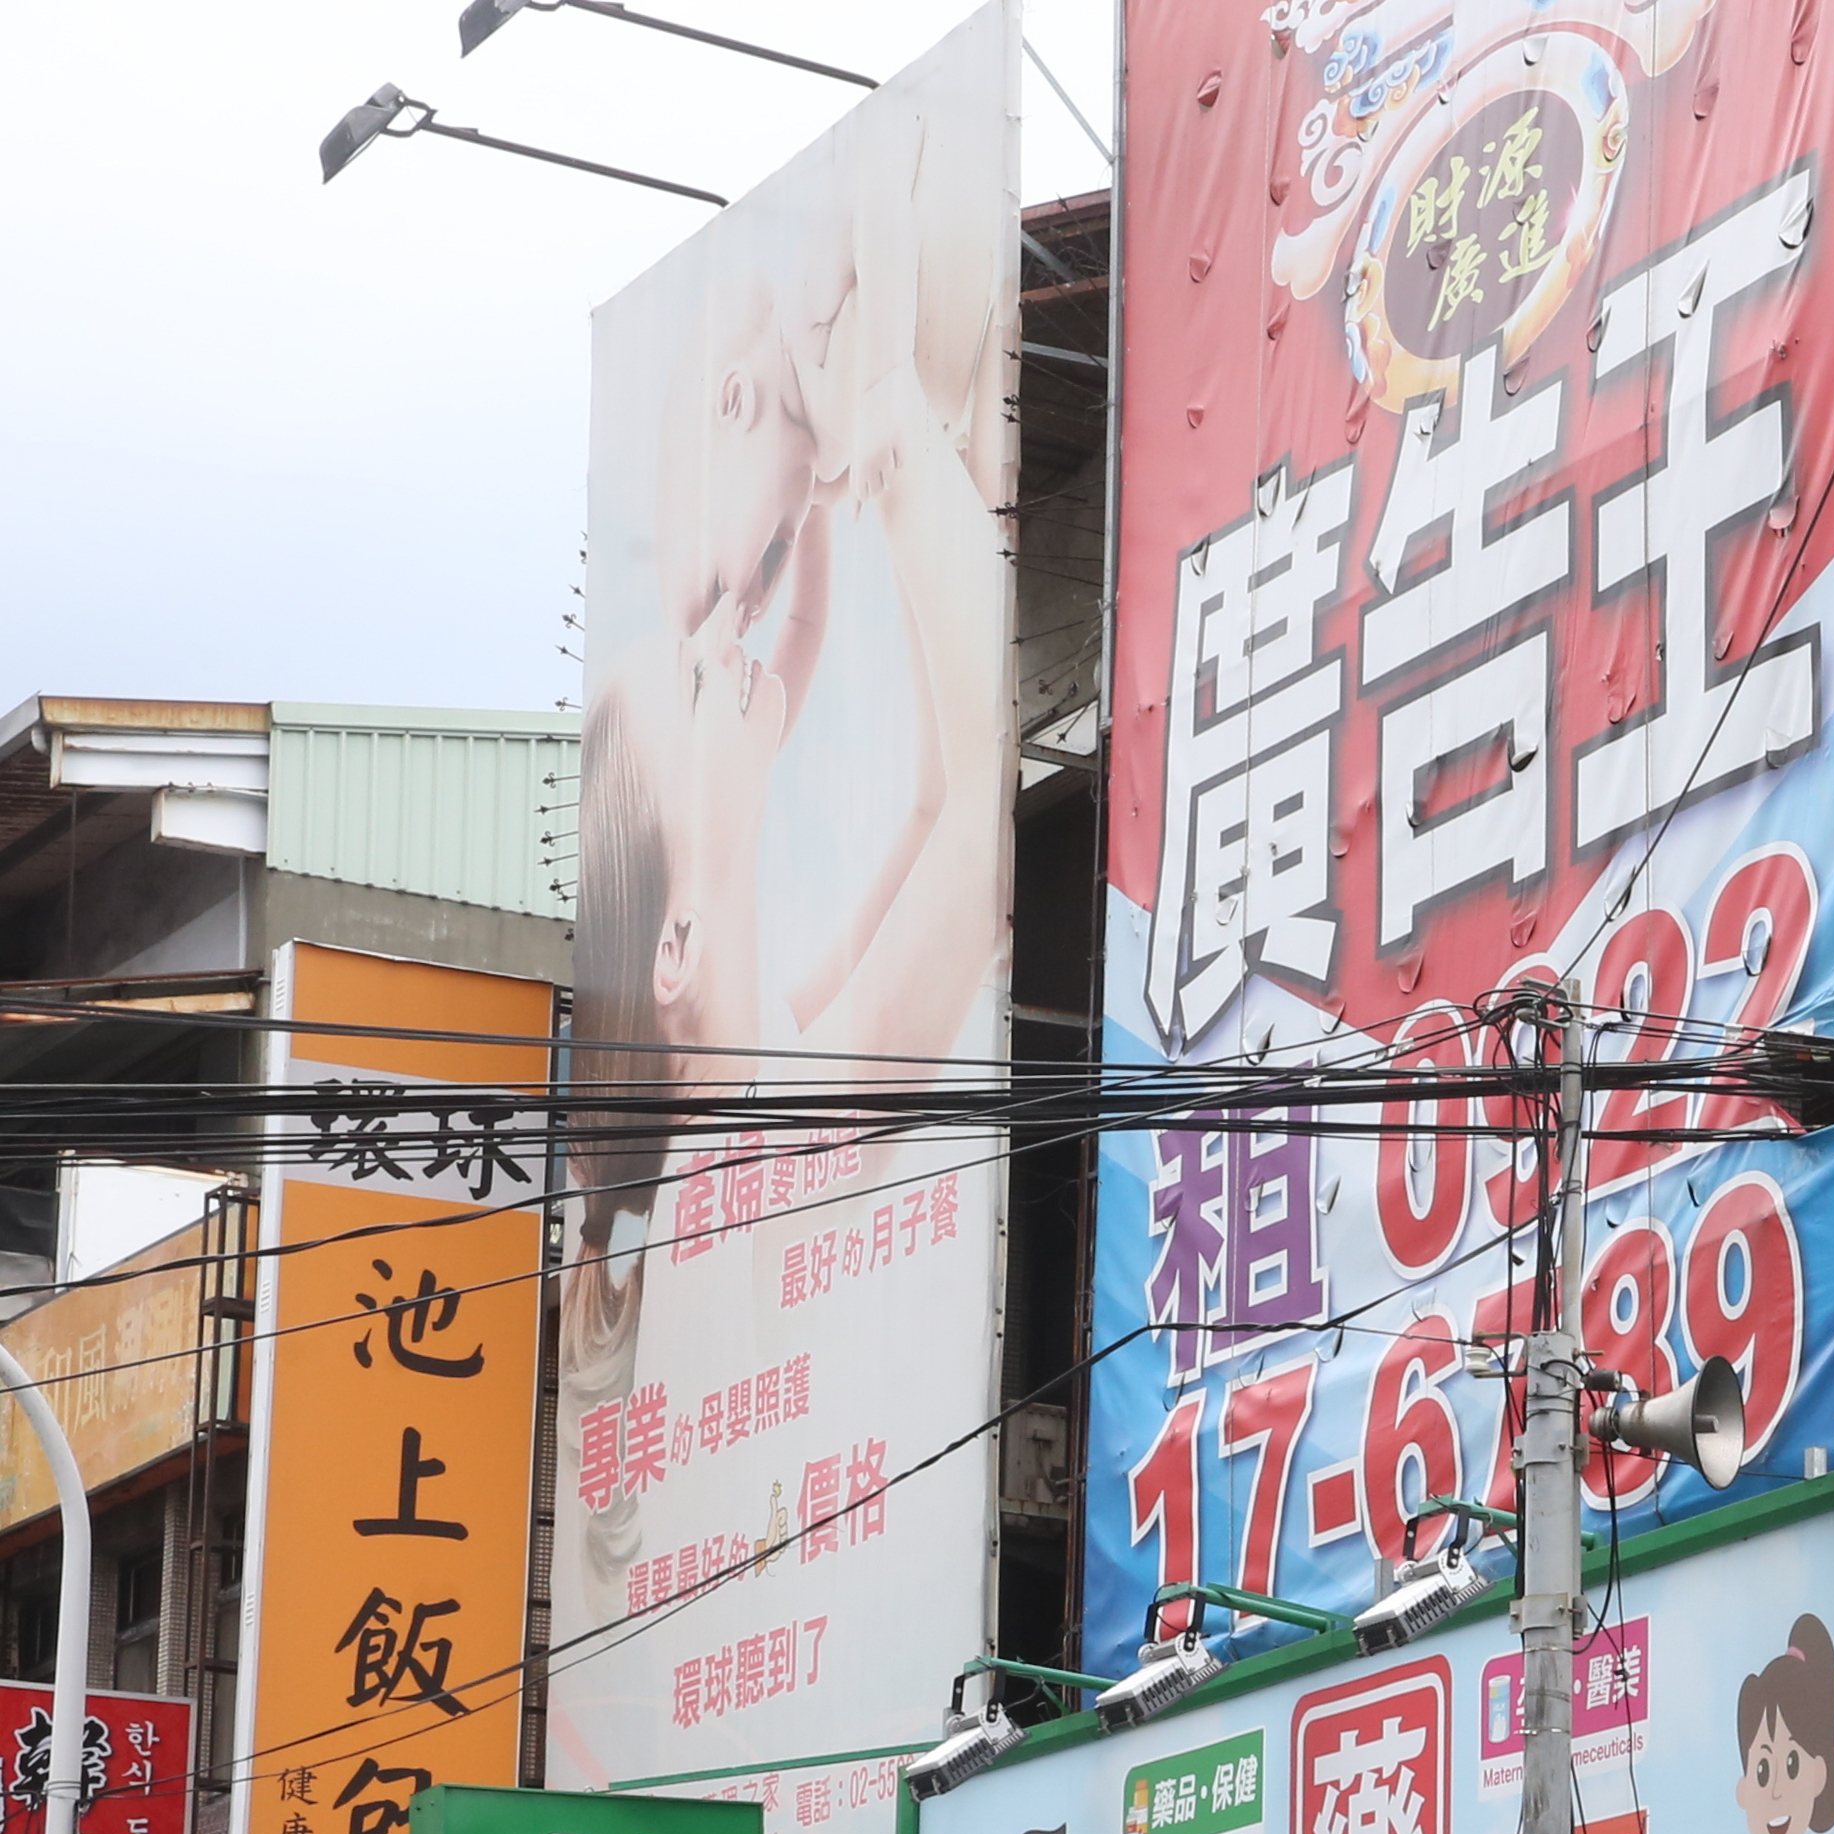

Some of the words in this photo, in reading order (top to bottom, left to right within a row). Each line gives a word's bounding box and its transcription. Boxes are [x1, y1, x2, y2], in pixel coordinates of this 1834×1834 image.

[1145, 150, 1825, 1062] 廣告王
[307, 1076, 535, 1202] 環球
[1373, 843, 1818, 1280] 0922
[670, 1110, 861, 1266] 產婦要的是
[780, 1174, 959, 1311] 最好的月子餐
[1148, 1065, 1332, 1388] 租
[576, 1352, 813, 1512] 專業的母嬰照護
[626, 1532, 751, 1620] 還要最好的
[797, 1436, 889, 1564] 價格
[672, 1614, 829, 1731] 環球聽到了
[121, 1720, 161, 1797] 한식
